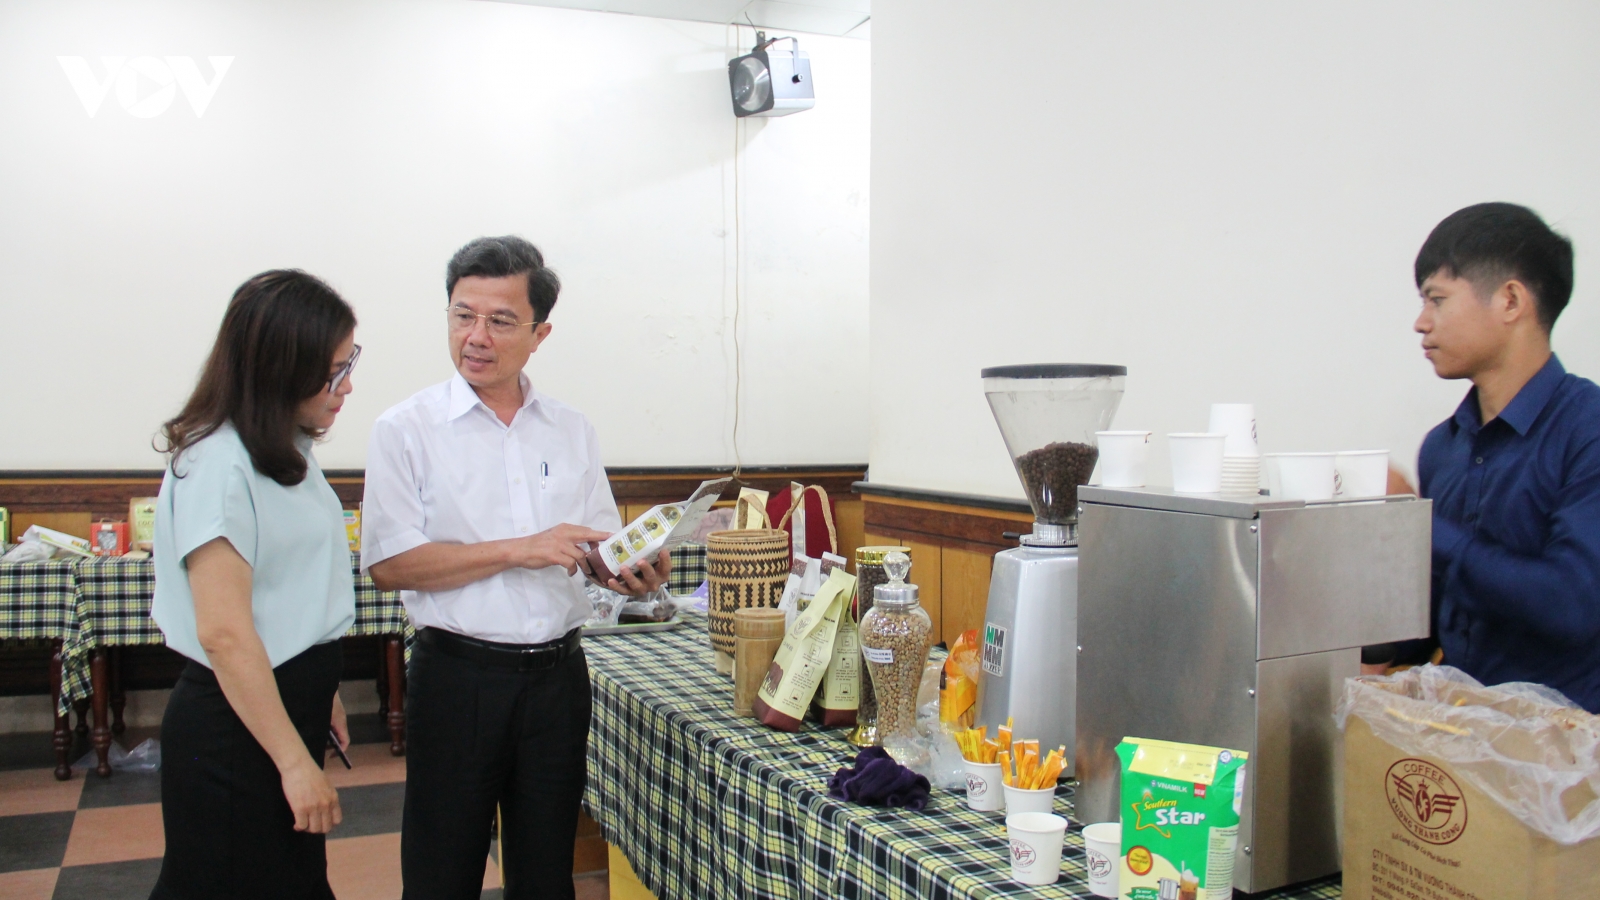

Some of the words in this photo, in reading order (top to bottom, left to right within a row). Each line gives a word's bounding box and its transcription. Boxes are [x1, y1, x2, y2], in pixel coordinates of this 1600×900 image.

[1404, 763, 1445, 783] COFFEE
[1157, 781, 1188, 793] VINAMILK
[1143, 798, 1177, 811] Southern
[1155, 807, 1206, 826] Star
